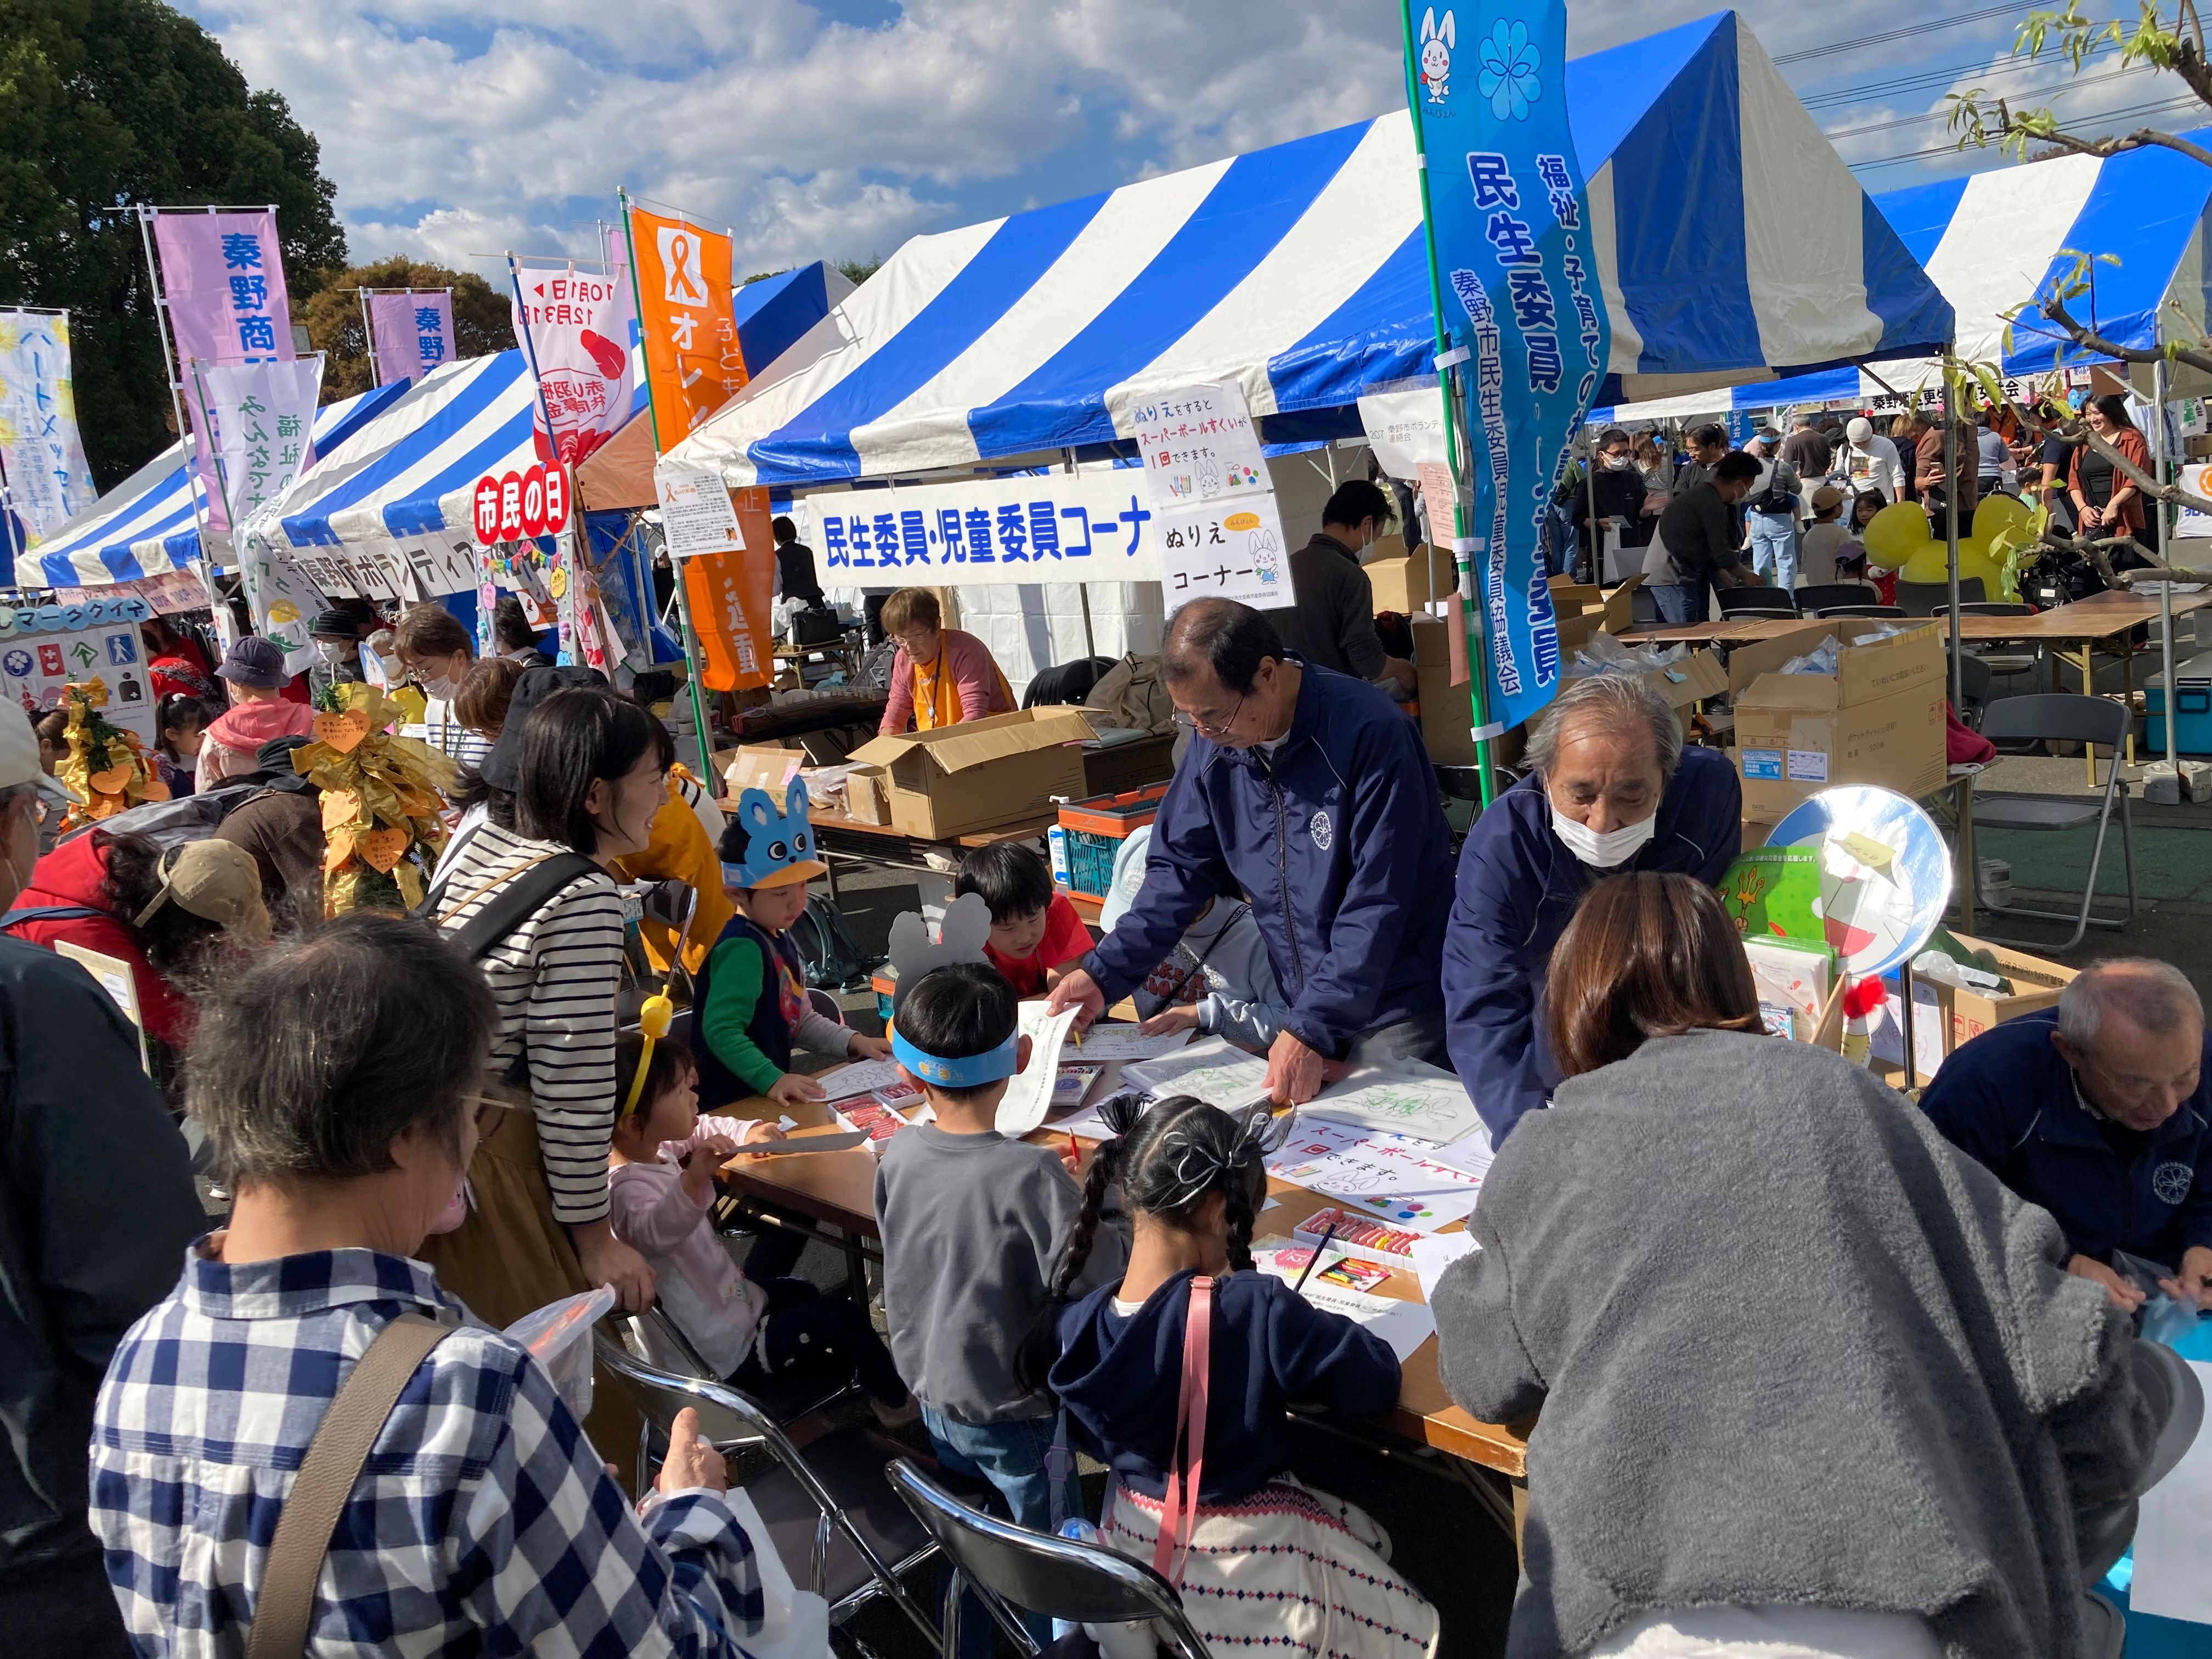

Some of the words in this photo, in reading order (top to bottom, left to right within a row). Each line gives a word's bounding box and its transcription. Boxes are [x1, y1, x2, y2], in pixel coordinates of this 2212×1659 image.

[221, 232, 278, 363] 秦野商
[415, 307, 445, 377] 秦野
[1134, 399, 1212, 424] ぬりえをすると
[1141, 416, 1248, 446] スーパーボールすくいが
[1369, 430, 1384, 440] 207
[1151, 447, 1216, 470] 1回できます。
[1452, 269, 1521, 695] 秦野市民生委員児童委員協議会
[477, 470, 564, 535] 市民の日
[823, 495, 1151, 568] 民生委員・児童委員コーナ
[1166, 521, 1226, 549] ぬりえ
[1173, 564, 1253, 590] コーナー
